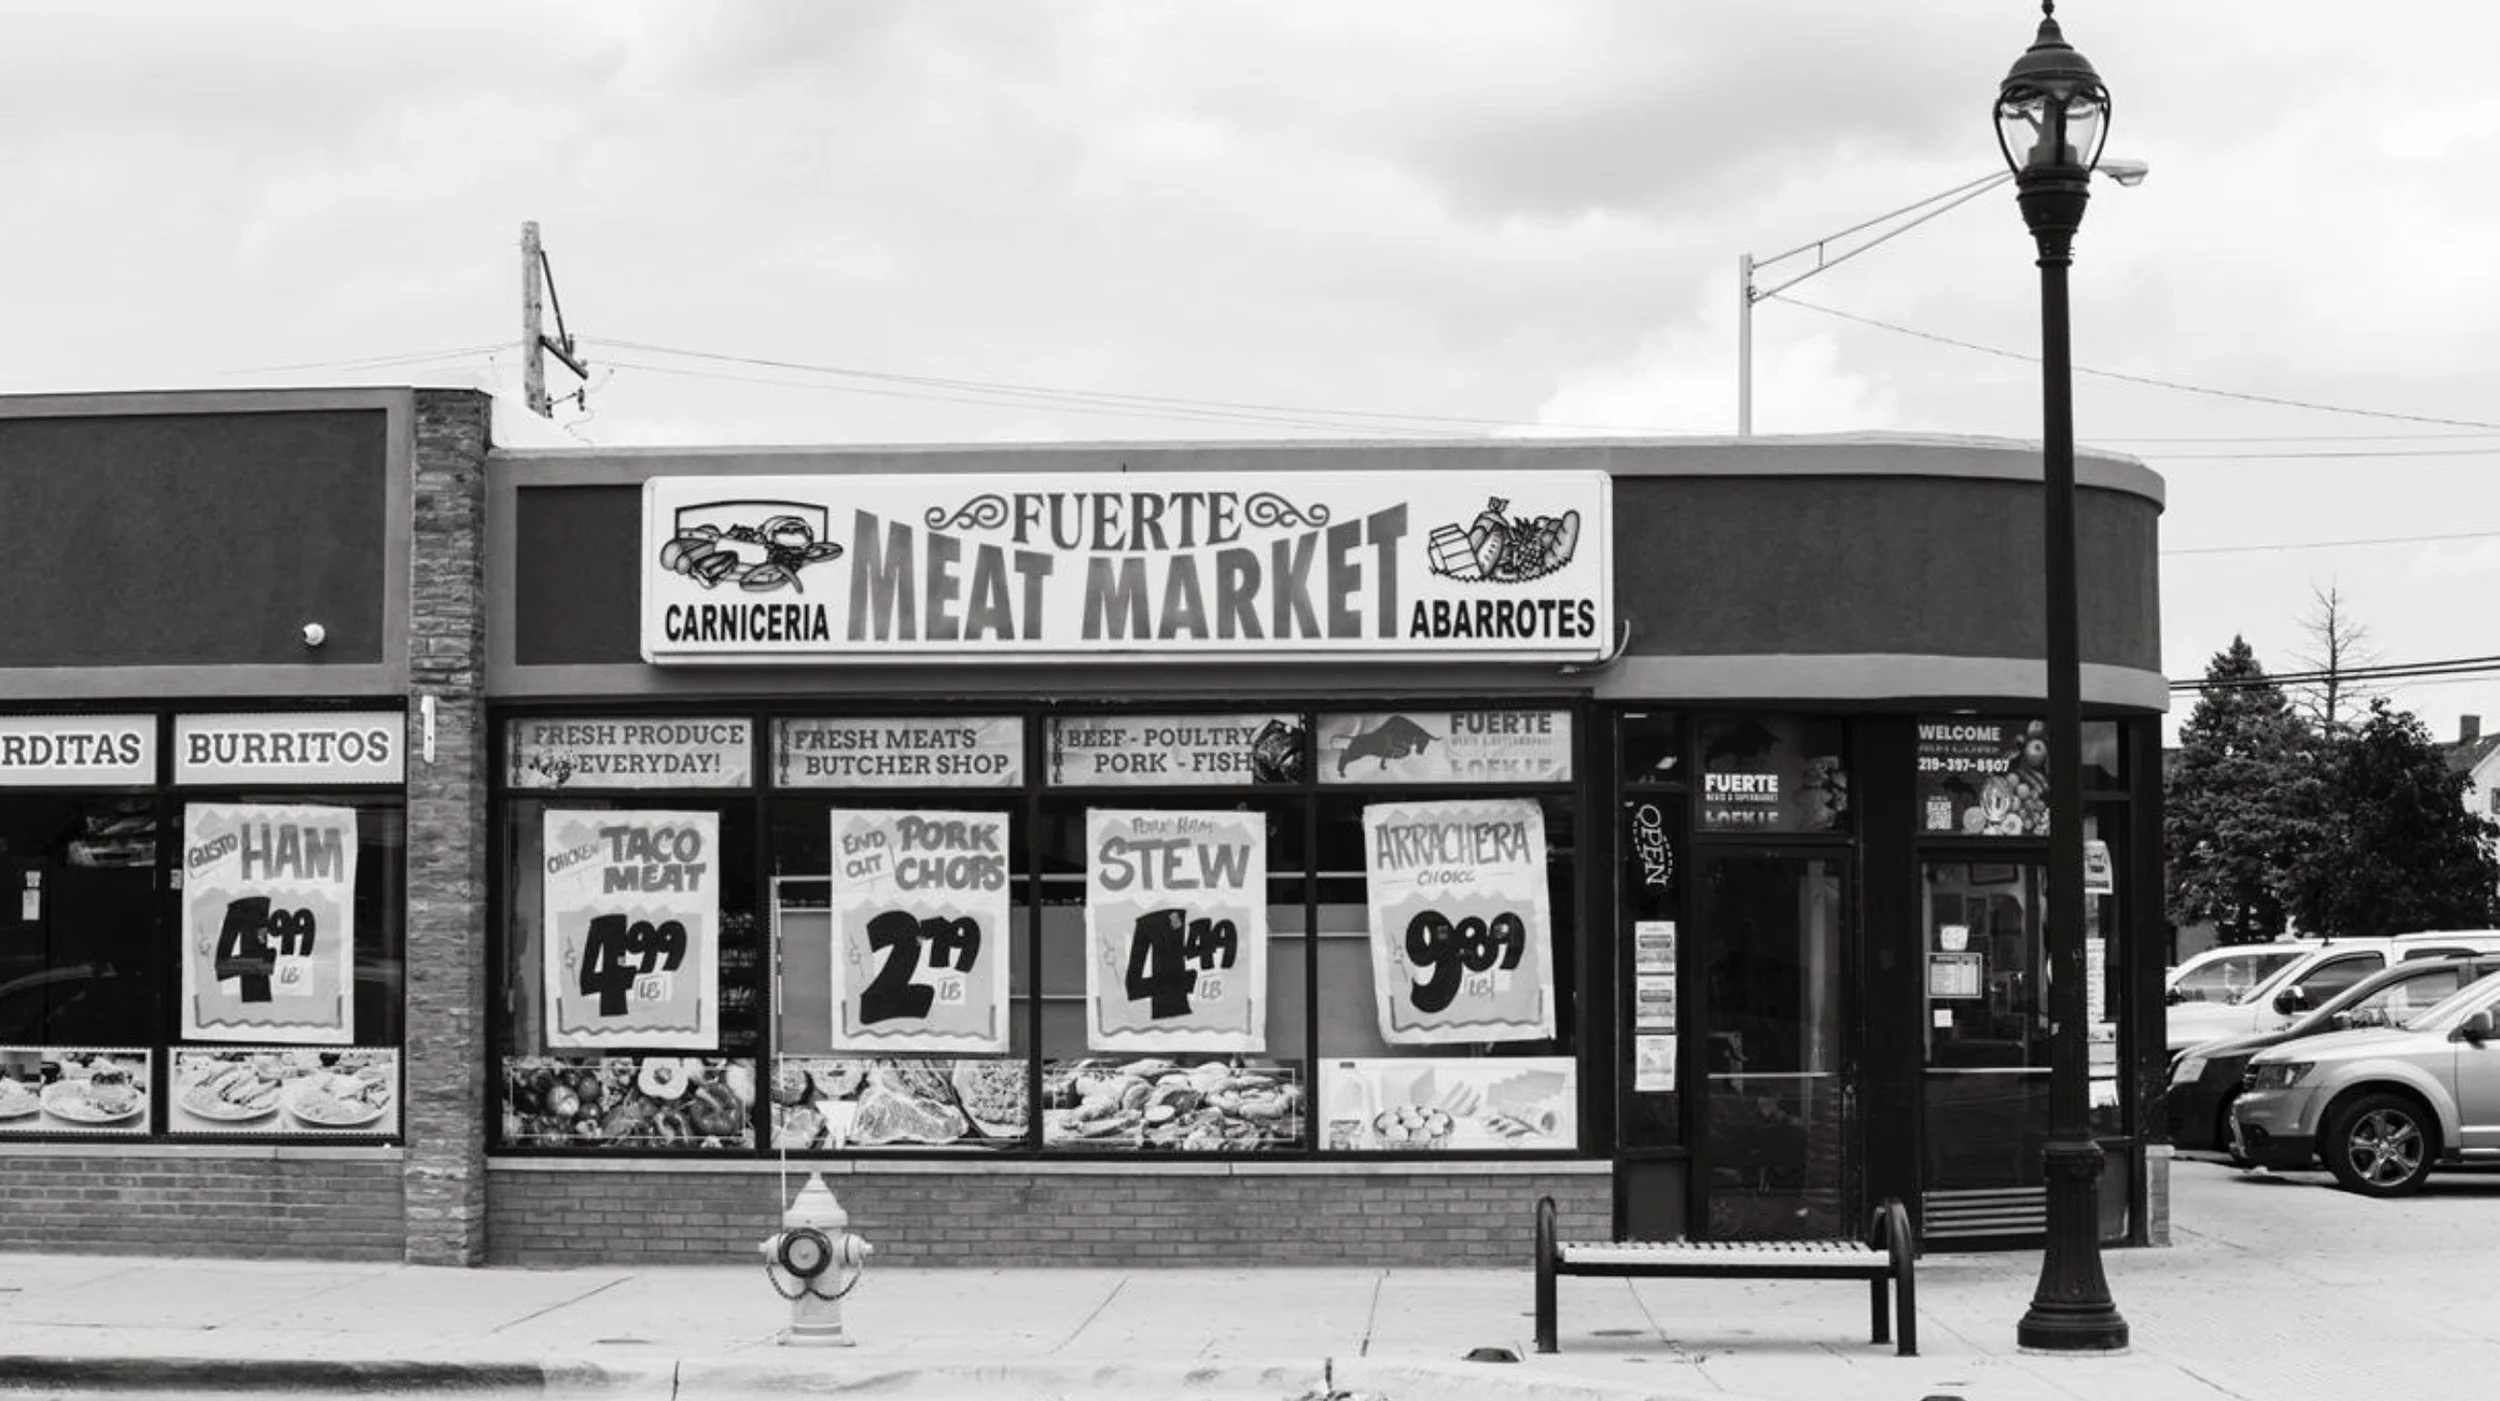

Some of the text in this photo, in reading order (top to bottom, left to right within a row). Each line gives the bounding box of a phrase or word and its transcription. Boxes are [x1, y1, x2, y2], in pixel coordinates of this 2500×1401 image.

[1011, 492, 1242, 551] FUERTE
[847, 501, 1408, 641] MEAT MARKET
[665, 603, 830, 641] CARNICERIA
[1410, 599, 1594, 638] ABARROTES
[535, 725, 744, 745] FRESH PRODUCE
[795, 728, 976, 749] FRESH MEATS
[1068, 729, 1126, 747] BEEF
[1144, 728, 1257, 747] POULTRY
[1451, 711, 1552, 734] FUERTE
[1918, 724, 2001, 741] WELCOME
[2, 734, 141, 765] RDITAS
[188, 731, 389, 764] BURRITOS
[578, 754, 720, 773] EVERYDAY!
[1094, 753, 1167, 773] PORK
[1192, 752, 1254, 772] FISH
[806, 754, 1008, 775] BUTCHER SHOP
[1705, 773, 1778, 792] FUERTE
[599, 826, 702, 863] TACO
[843, 830, 886, 854] END
[896, 815, 1001, 852] PORK
[1375, 821, 1531, 870] ARRACHERA
[1639, 804, 1666, 886] OPEN
[188, 833, 238, 868] GUSTO
[241, 823, 344, 883] HAM
[846, 853, 882, 878] CUT
[1099, 836, 1251, 891] STEW
[603, 863, 707, 894] MEAT
[896, 855, 1006, 891] CHOPS
